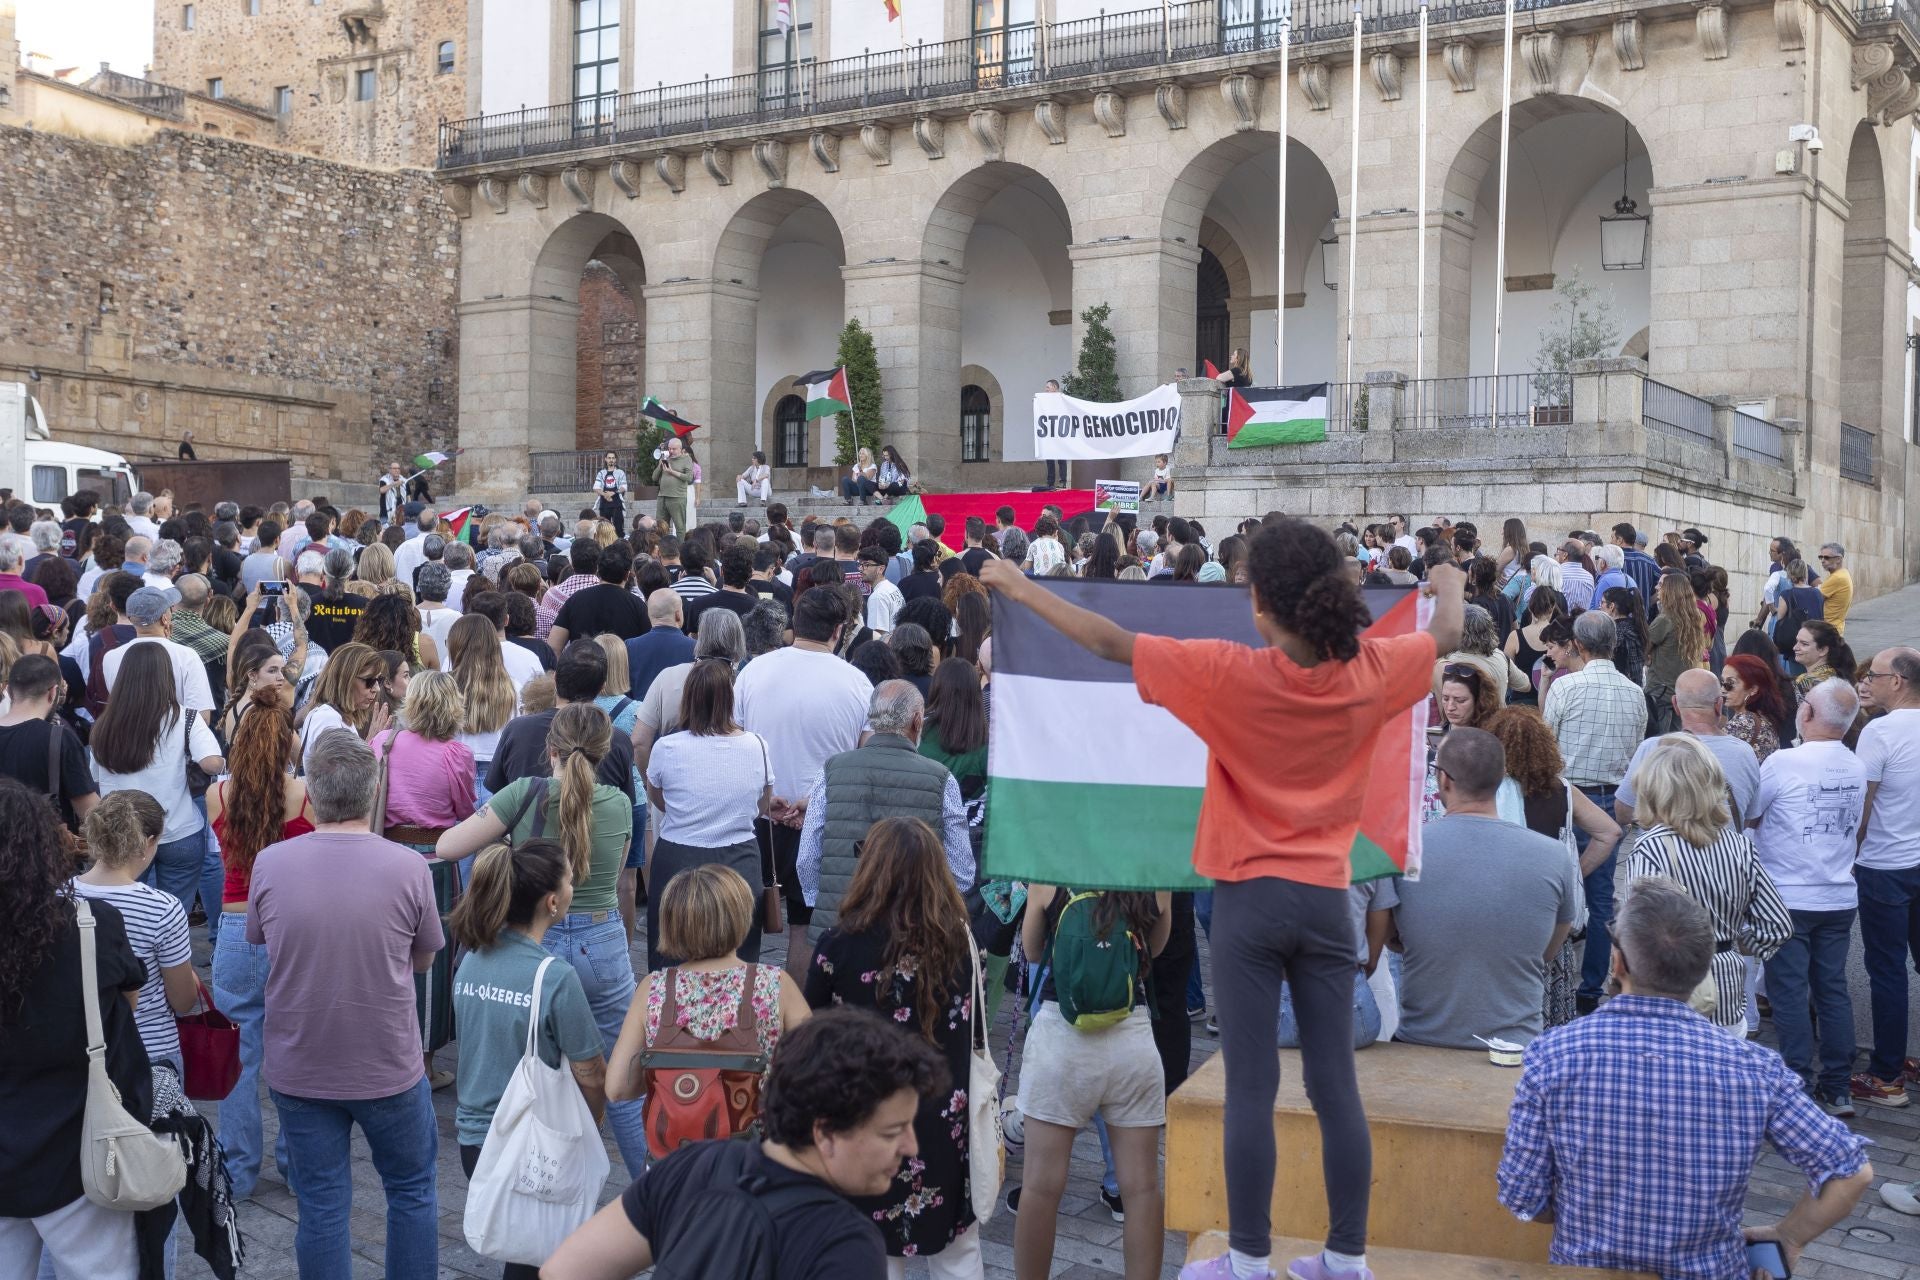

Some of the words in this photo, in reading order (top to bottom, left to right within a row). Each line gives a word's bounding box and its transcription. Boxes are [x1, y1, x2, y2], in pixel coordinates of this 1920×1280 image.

[1036, 414, 1080, 438] STOP
[1082, 406, 1178, 438] GENOCIDIO
[463, 982, 532, 1008] AL-QÁZERES
[530, 1145, 562, 1169] live.
[527, 1160, 558, 1184] love.
[520, 1175, 555, 1196] smile.
